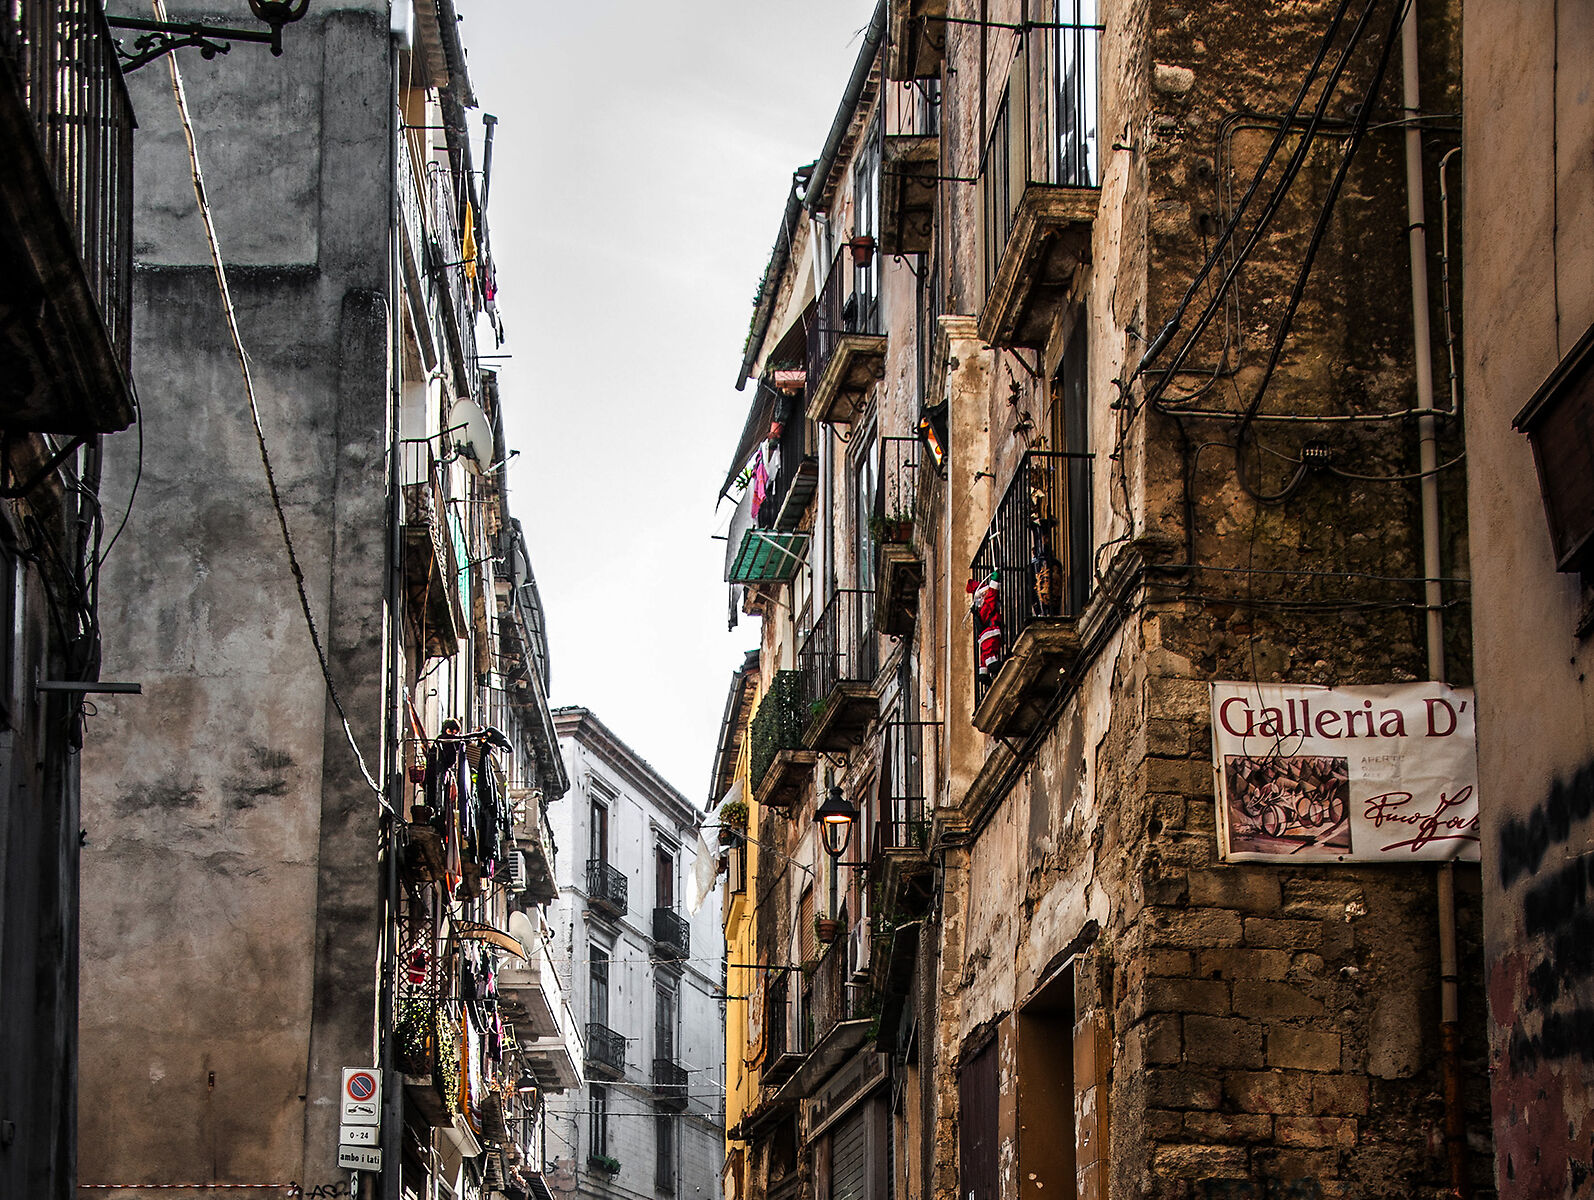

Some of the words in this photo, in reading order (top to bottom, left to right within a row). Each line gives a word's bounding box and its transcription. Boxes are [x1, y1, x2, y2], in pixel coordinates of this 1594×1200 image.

[1219, 697, 1408, 739] Galleria
[1423, 698, 1467, 738] D'
[349, 1131, 355, 1139] 0
[360, 1131, 369, 1140] 24
[339, 1152, 360, 1162] ambo
[366, 1153, 380, 1165] lati
